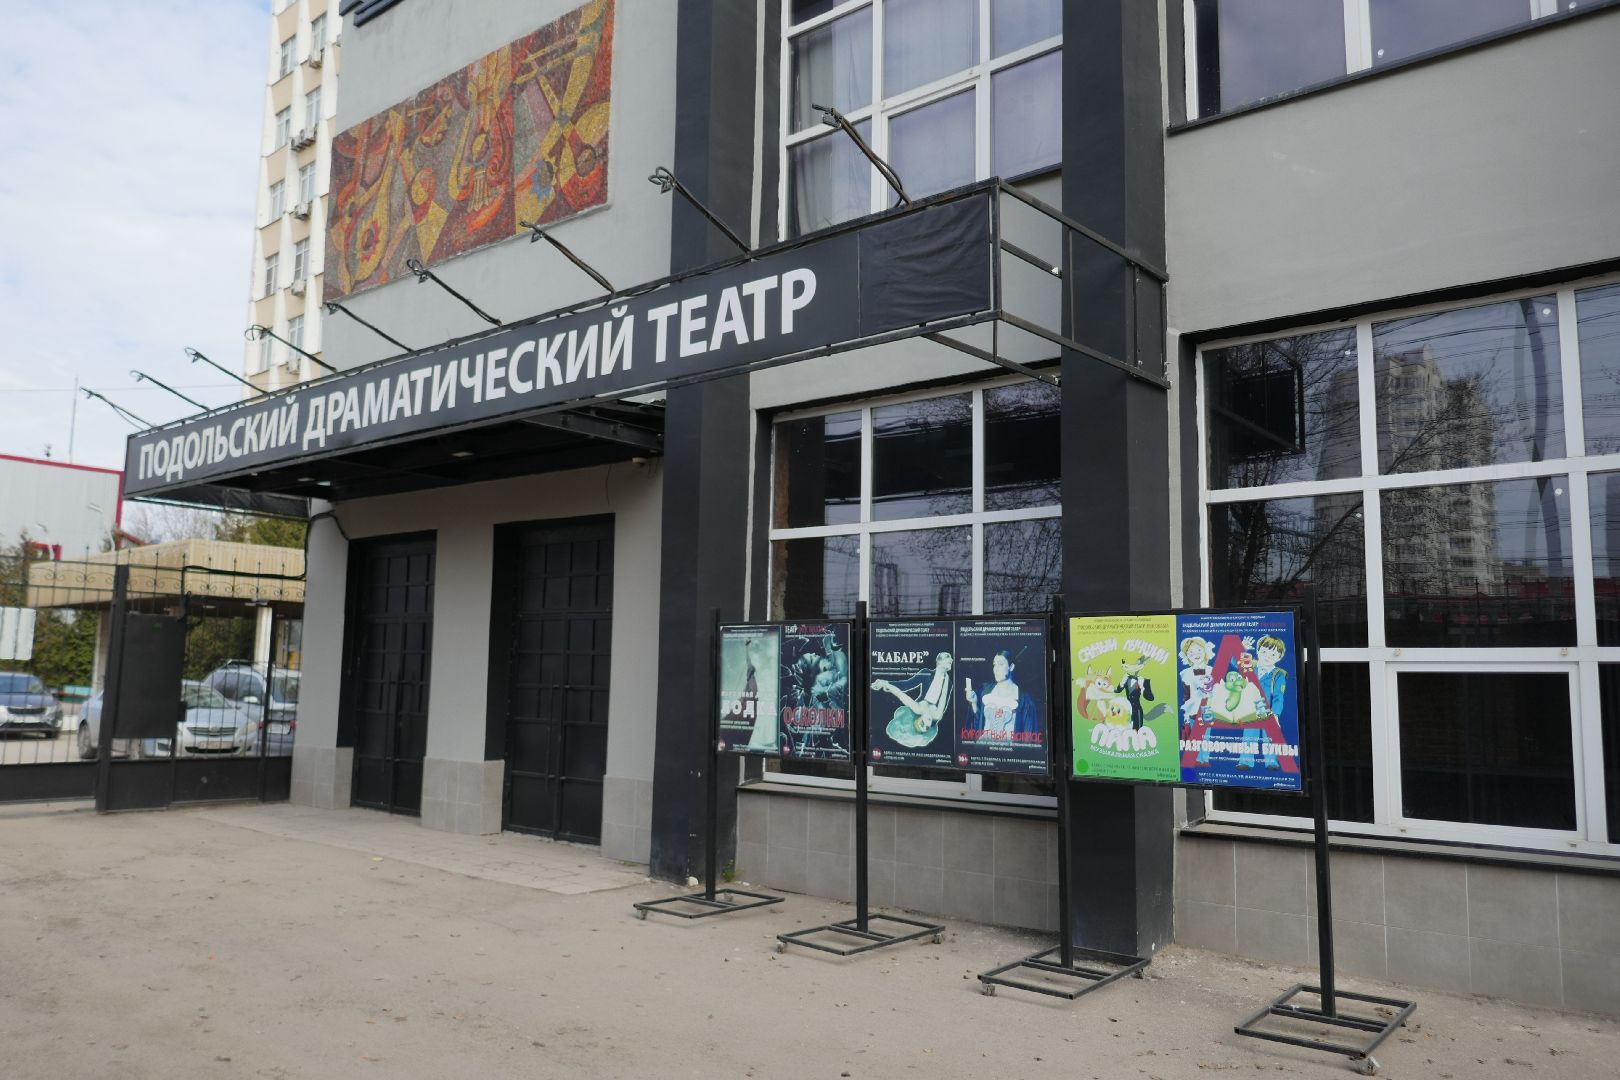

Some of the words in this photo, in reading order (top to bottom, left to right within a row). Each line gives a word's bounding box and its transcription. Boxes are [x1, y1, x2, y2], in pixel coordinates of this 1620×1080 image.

[138, 396, 300, 483] ПОДОЛЬСКИЙ
[301, 305, 635, 451] ДРАМАТИЧЕСКИЙ
[647, 267, 817, 363] ТЕАТР
[783, 706, 846, 729] ОСКОЛКИ
[960, 727, 1008, 742] КУРОРТНЫЙ
[1010, 730, 1044, 744] ВОПРОС
[1090, 723, 1157, 752] ПАПА
[1179, 739, 1260, 755] РАЗГОВОРЧИВЫЕ
[1262, 743, 1299, 757] БУКВЫ
